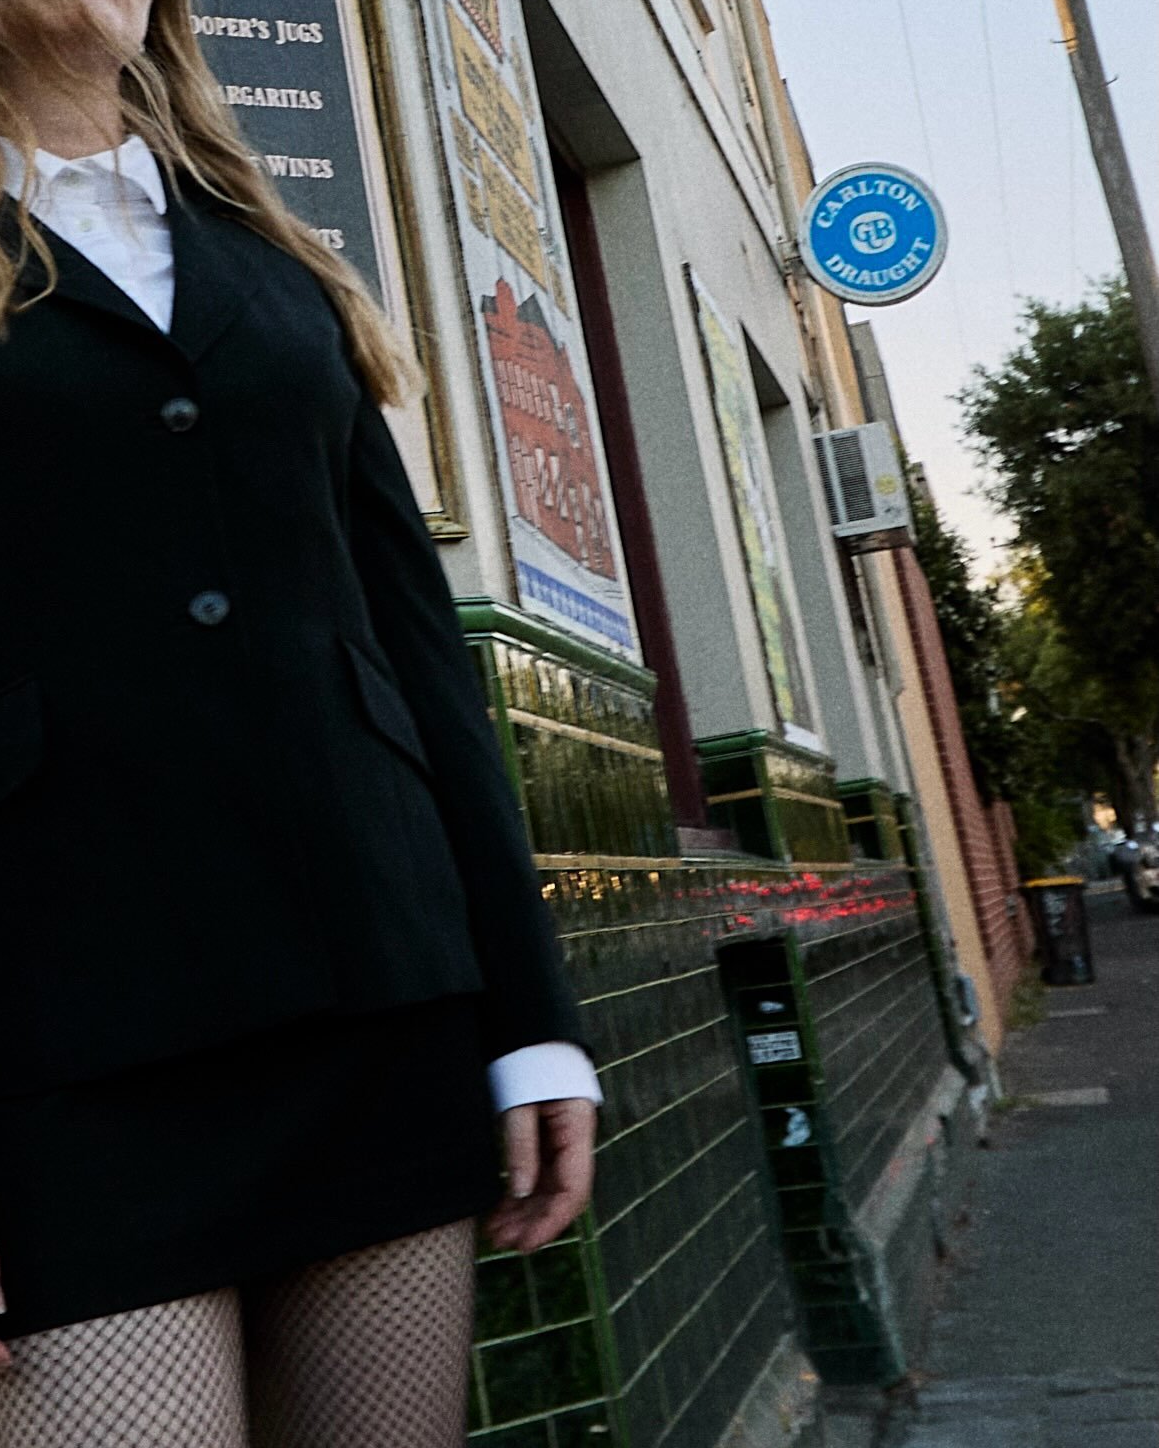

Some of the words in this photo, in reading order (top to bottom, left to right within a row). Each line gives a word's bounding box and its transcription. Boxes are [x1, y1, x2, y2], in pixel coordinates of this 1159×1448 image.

[189, 14, 271, 40] OOPER'S
[275, 19, 324, 45] JUGS
[265, 154, 335, 179] WINES
[816, 180, 923, 228] CARLTON
[825, 237, 931, 286] DRAUGHT
